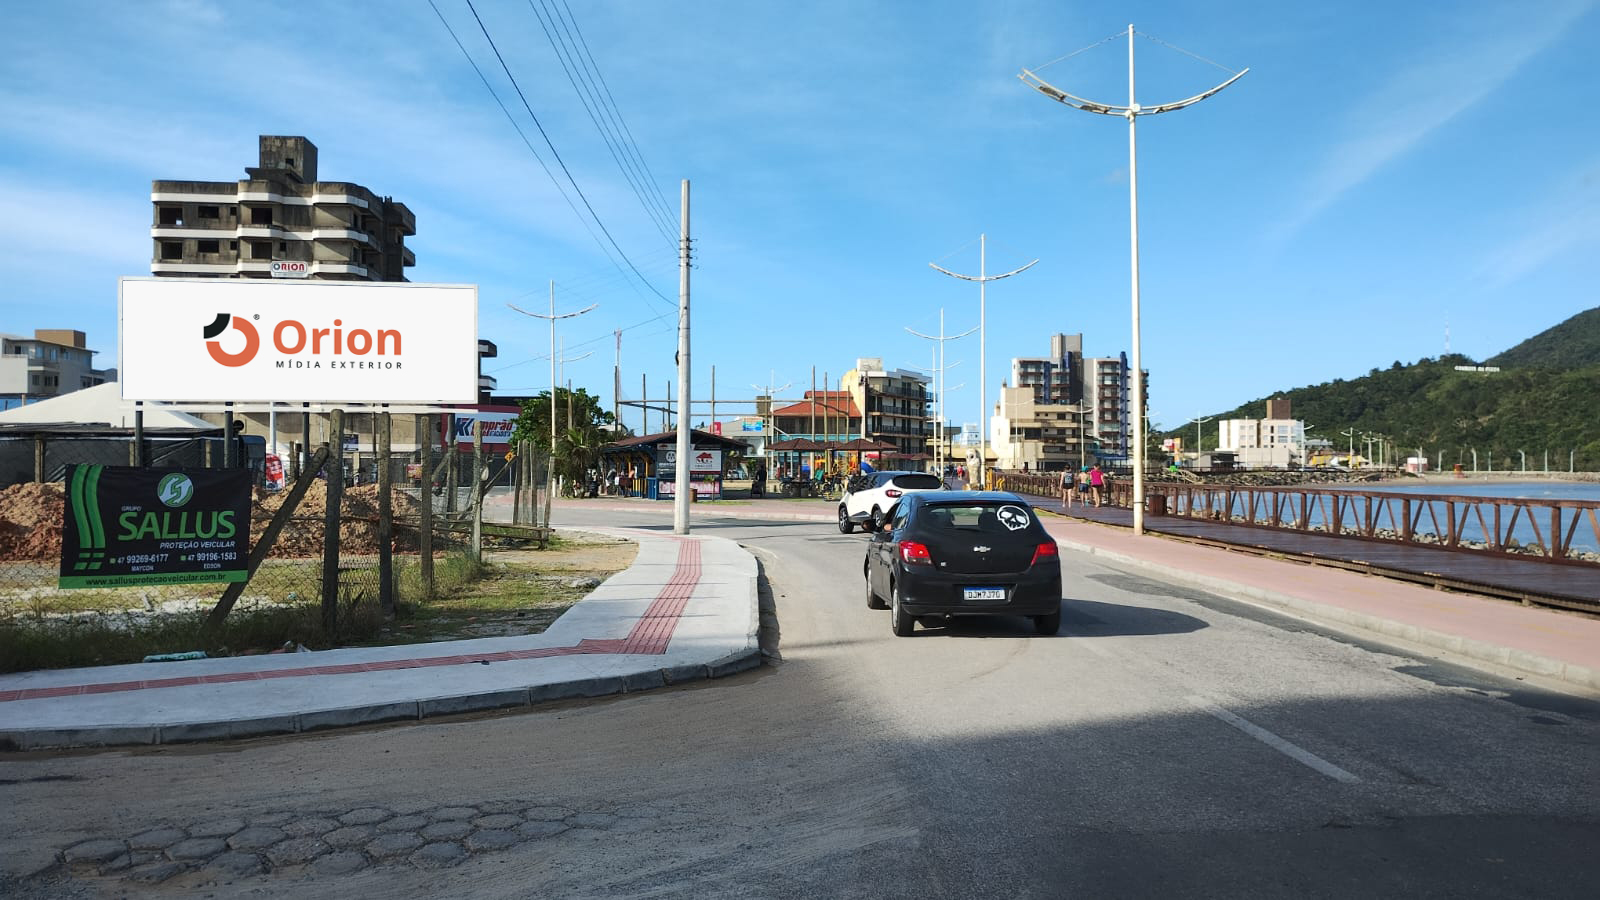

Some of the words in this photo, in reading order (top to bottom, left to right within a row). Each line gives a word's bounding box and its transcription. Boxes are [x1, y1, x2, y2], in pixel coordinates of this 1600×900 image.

[274, 263, 305, 271] ORION
[273, 319, 402, 355] Orion
[276, 359, 321, 369] MÍDIA
[331, 361, 402, 370] EXTERIOR
[118, 511, 236, 540] SALLUS
[159, 541, 199, 549] PROTEÇÃO
[126, 554, 169, 564] 99269-6177
[196, 552, 237, 561] 99196-1583
[86, 573, 226, 586] www.sallusprotecaoveicular.com.br
